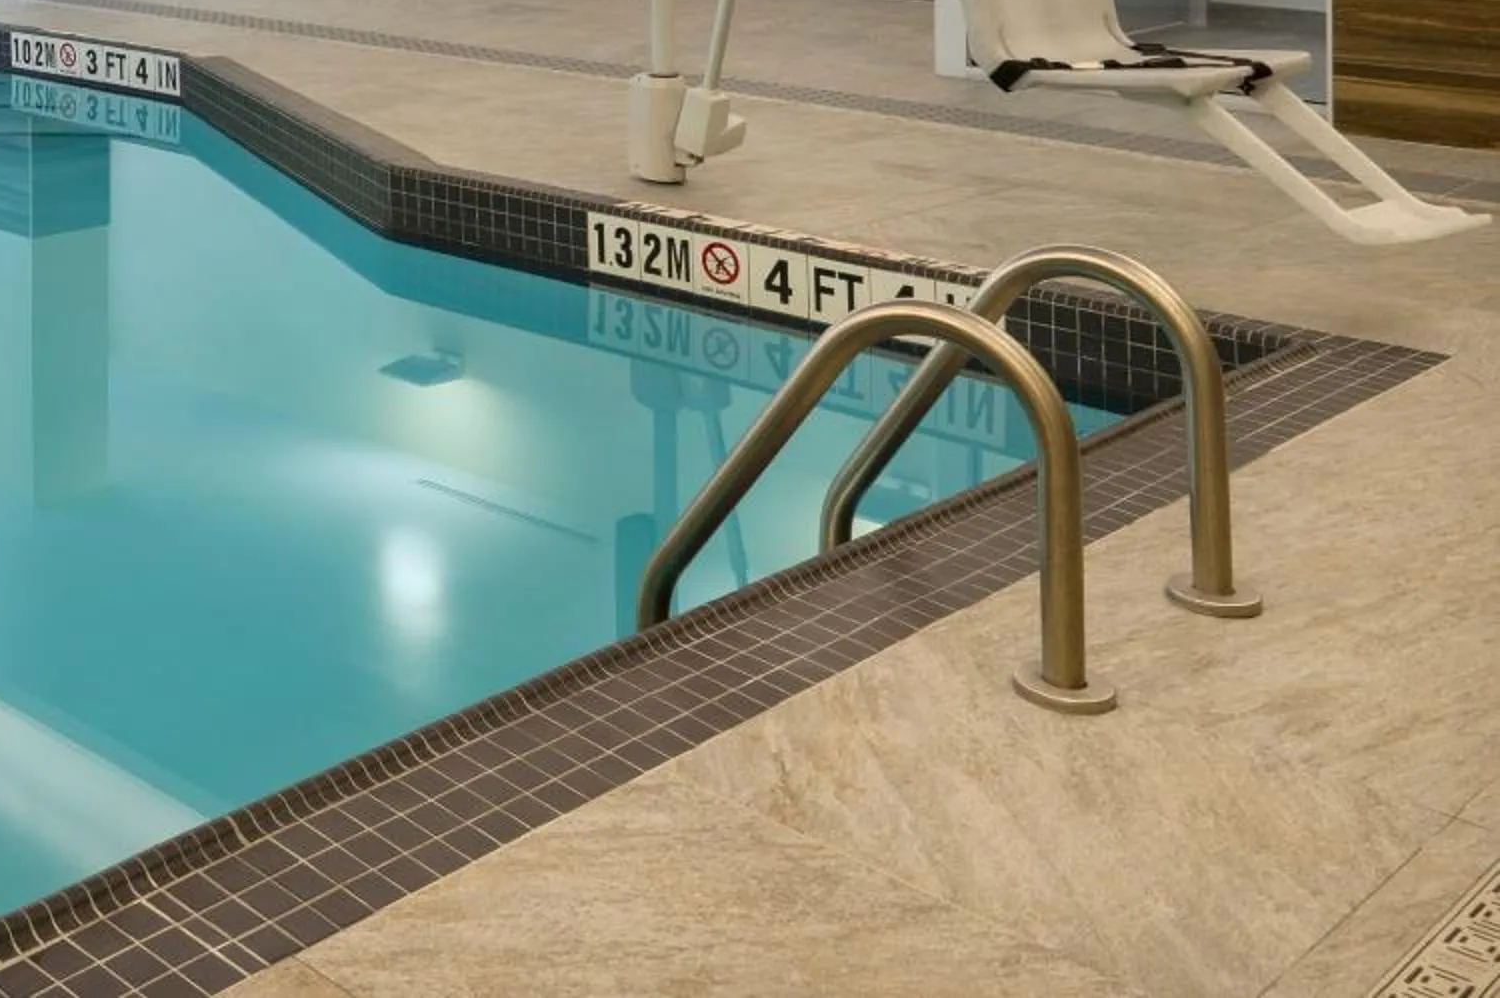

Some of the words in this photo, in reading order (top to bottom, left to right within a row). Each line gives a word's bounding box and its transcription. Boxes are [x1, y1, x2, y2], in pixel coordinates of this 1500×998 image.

[86, 49, 98, 75] 3
[106, 51, 126, 80] FT
[136, 58, 148, 85] 4
[158, 59, 177, 90] IN
[764, 260, 793, 305] 4
[814, 268, 864, 312] FT
